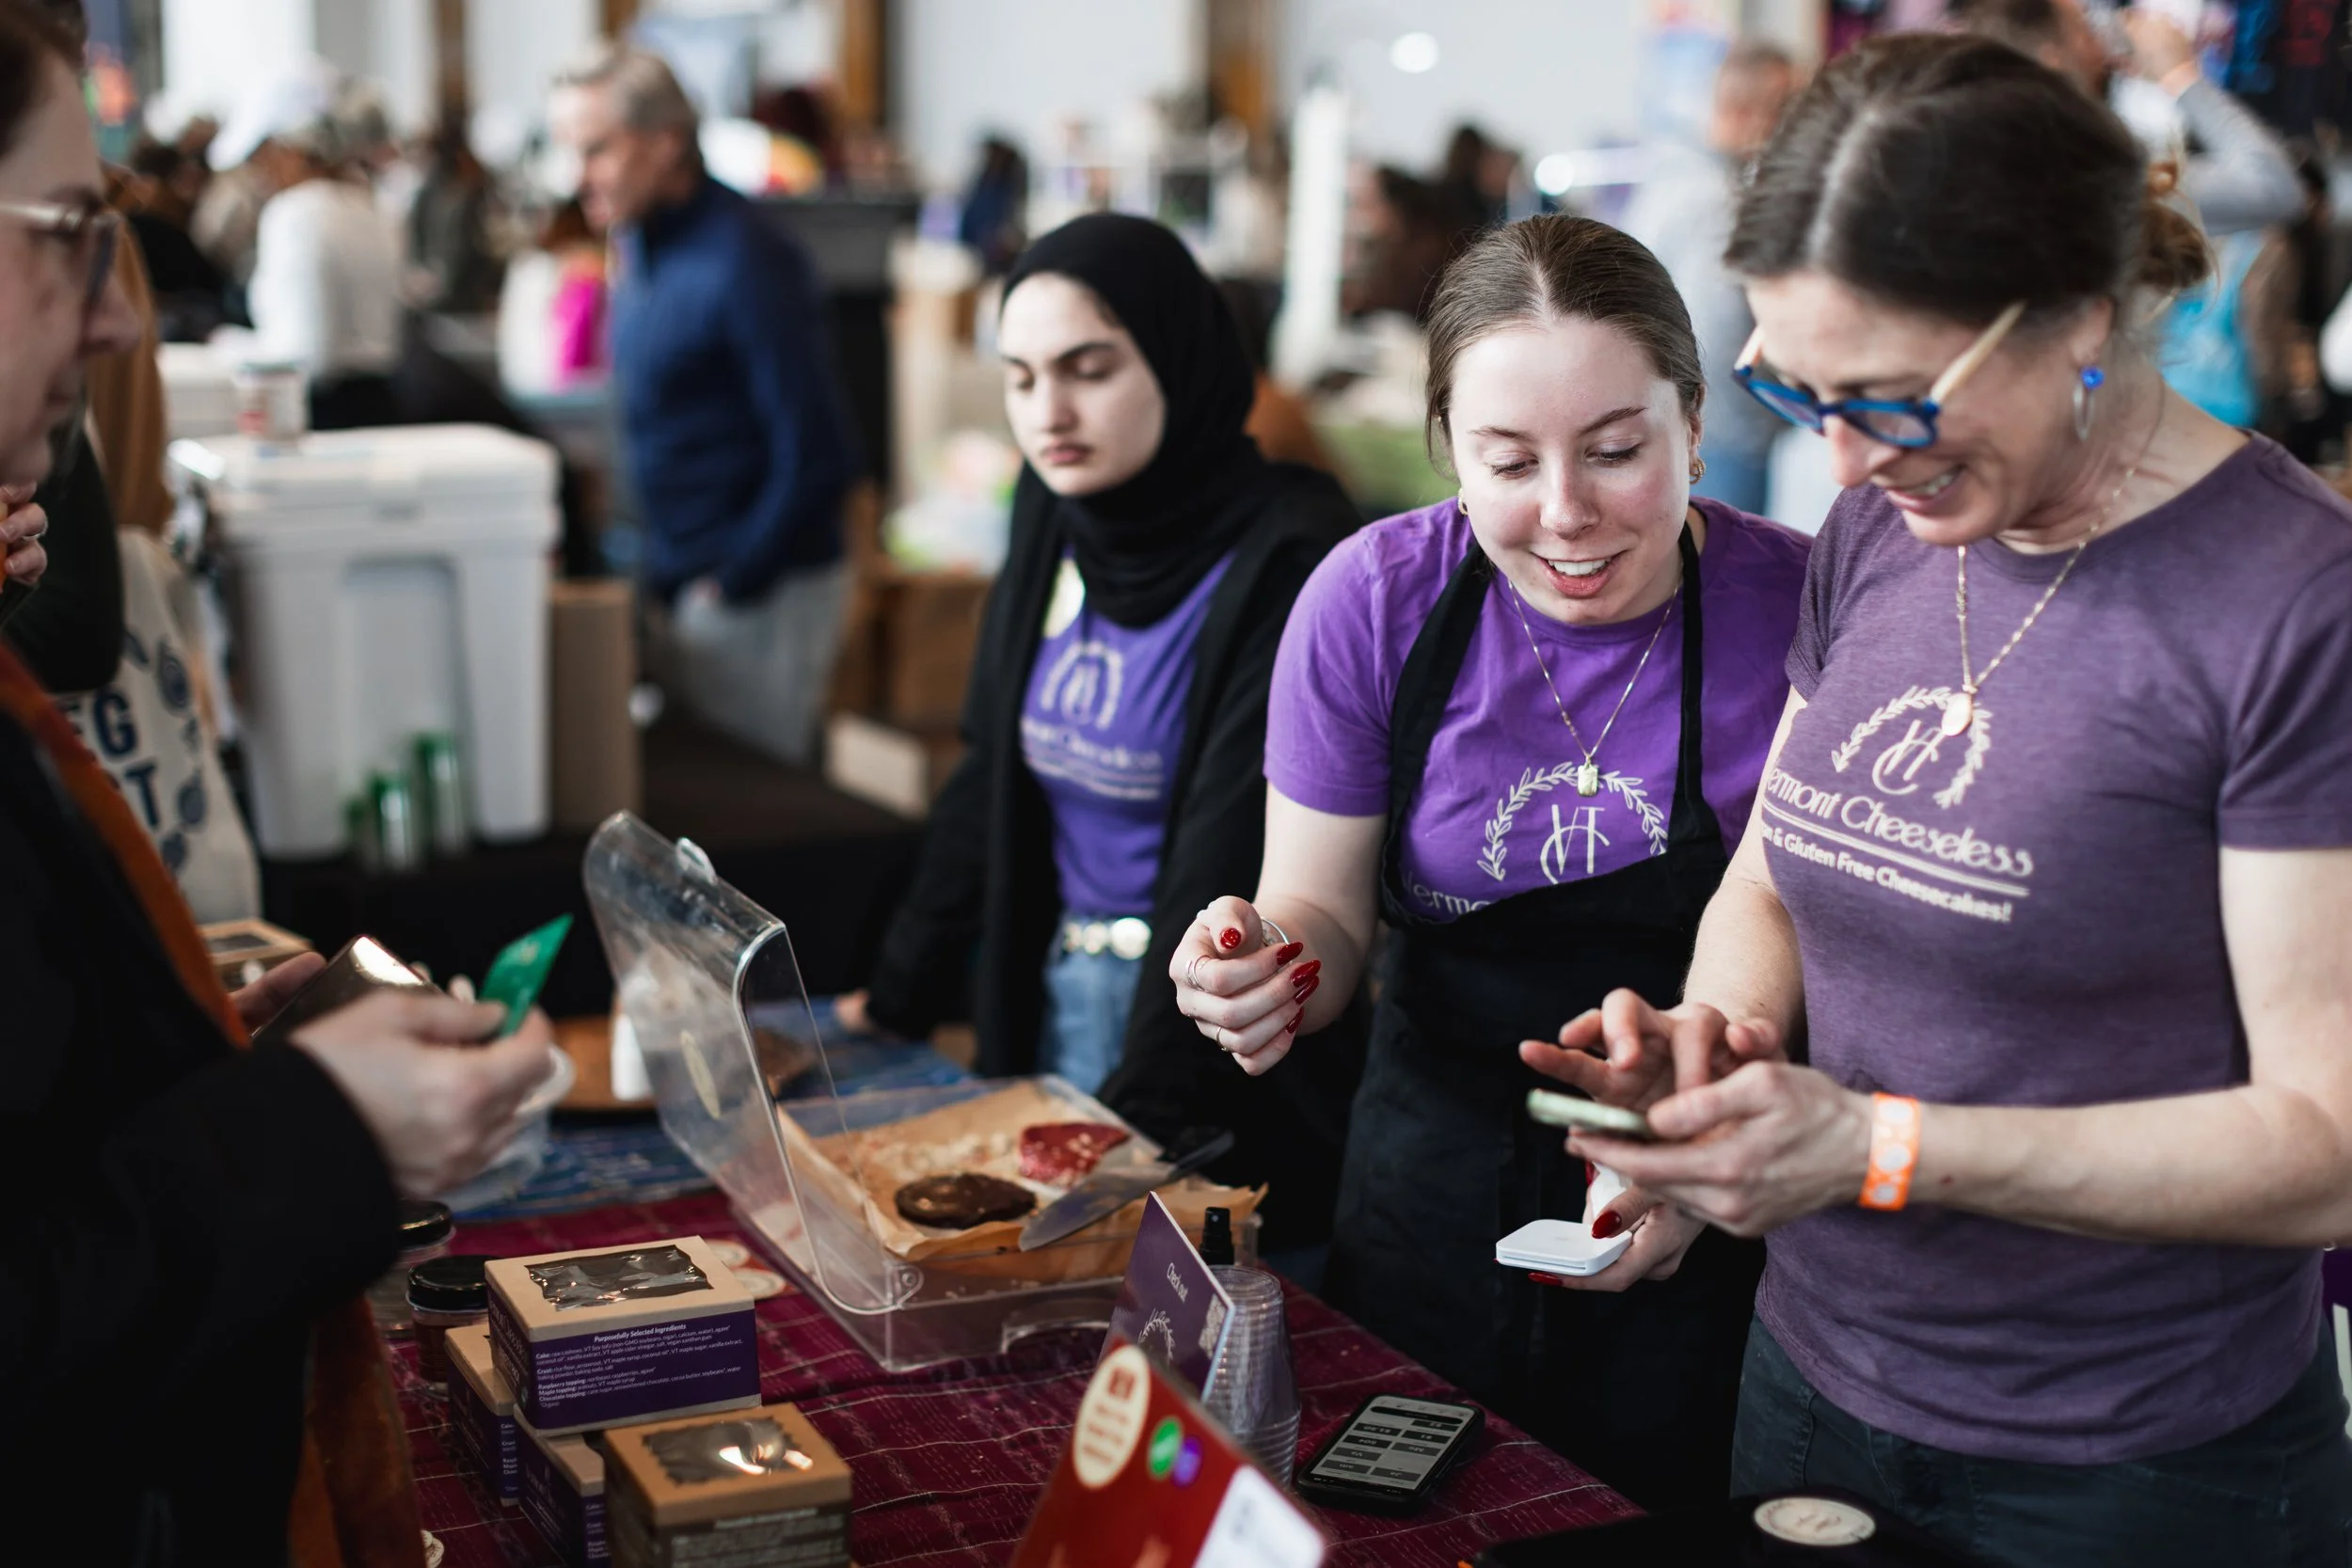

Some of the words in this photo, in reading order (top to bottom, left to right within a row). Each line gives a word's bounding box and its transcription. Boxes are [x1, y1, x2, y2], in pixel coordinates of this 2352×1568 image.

[1768, 767, 1841, 818] ermont
[1840, 796, 2033, 877] Cheeseless
[1784, 833, 1836, 867] Gluten
[1836, 850, 1875, 881] Free
[595, 1332, 629, 1342] Purposefully
[630, 1328, 654, 1338] Selected
[655, 1324, 686, 1334] Ingredients
